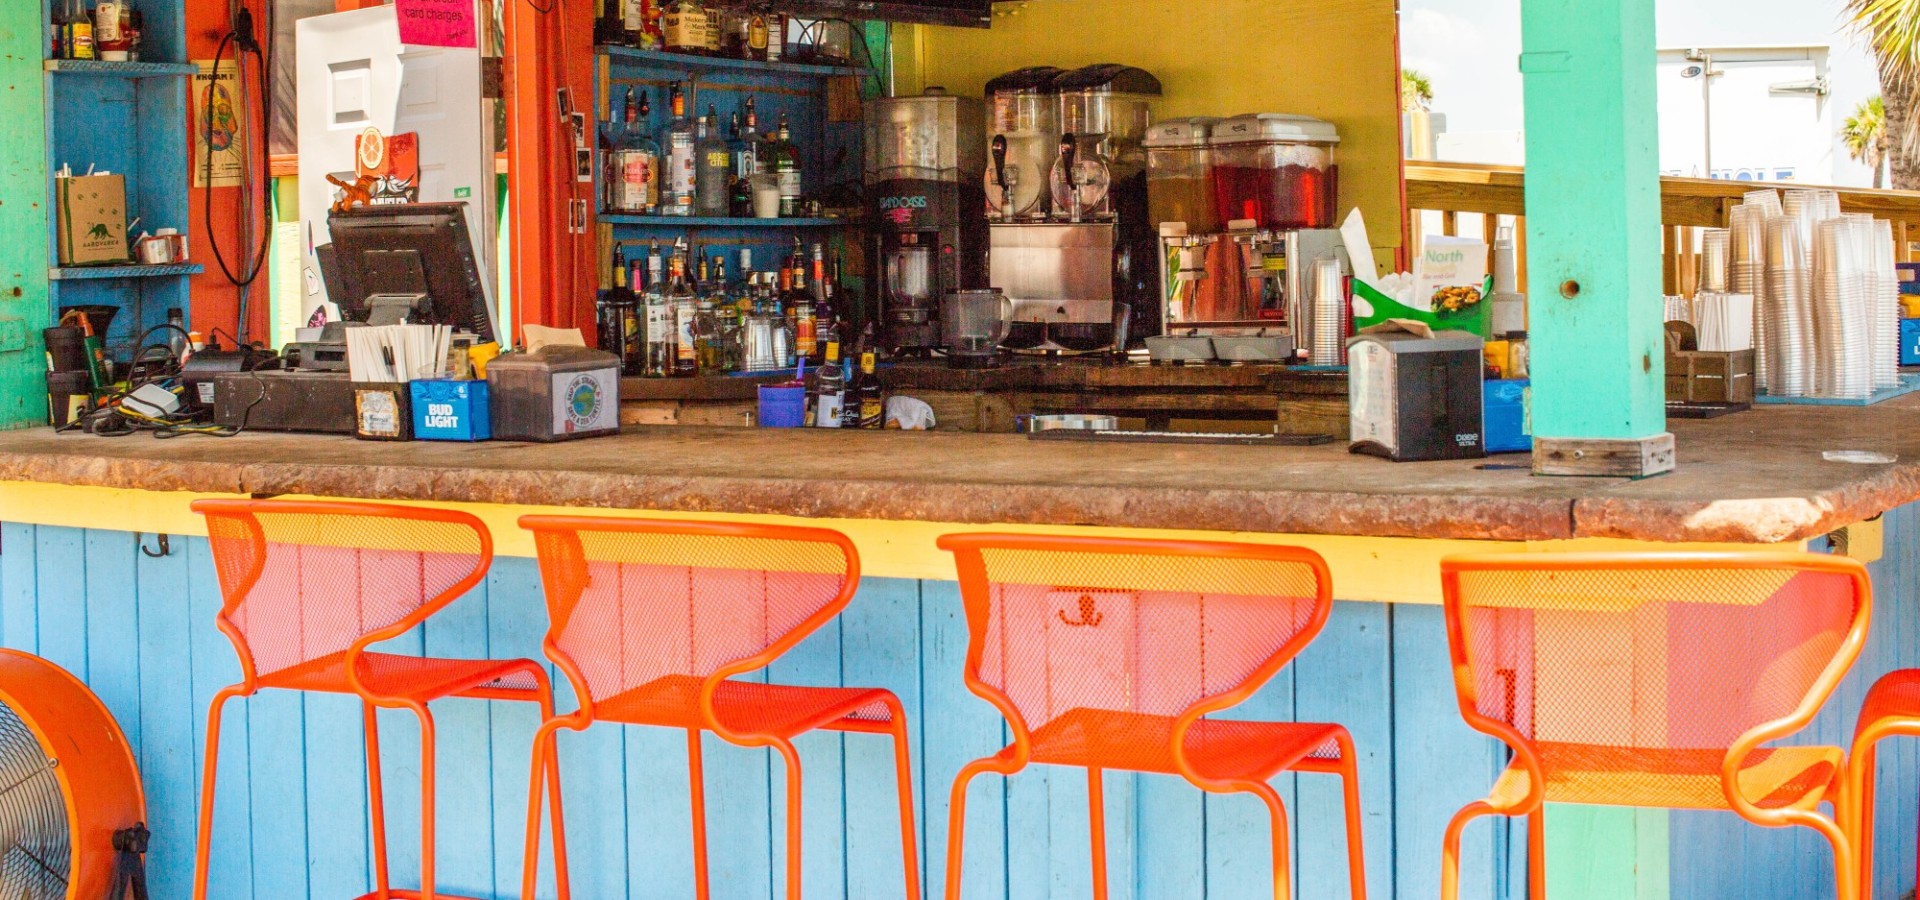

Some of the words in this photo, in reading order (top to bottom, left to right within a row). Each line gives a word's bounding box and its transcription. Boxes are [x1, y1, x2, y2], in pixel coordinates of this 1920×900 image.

[404, 7, 424, 18] card
[427, 8, 463, 23] charges
[1425, 249, 1464, 263] North
[428, 403, 453, 416] BUD
[424, 415, 459, 428] LIGHT
